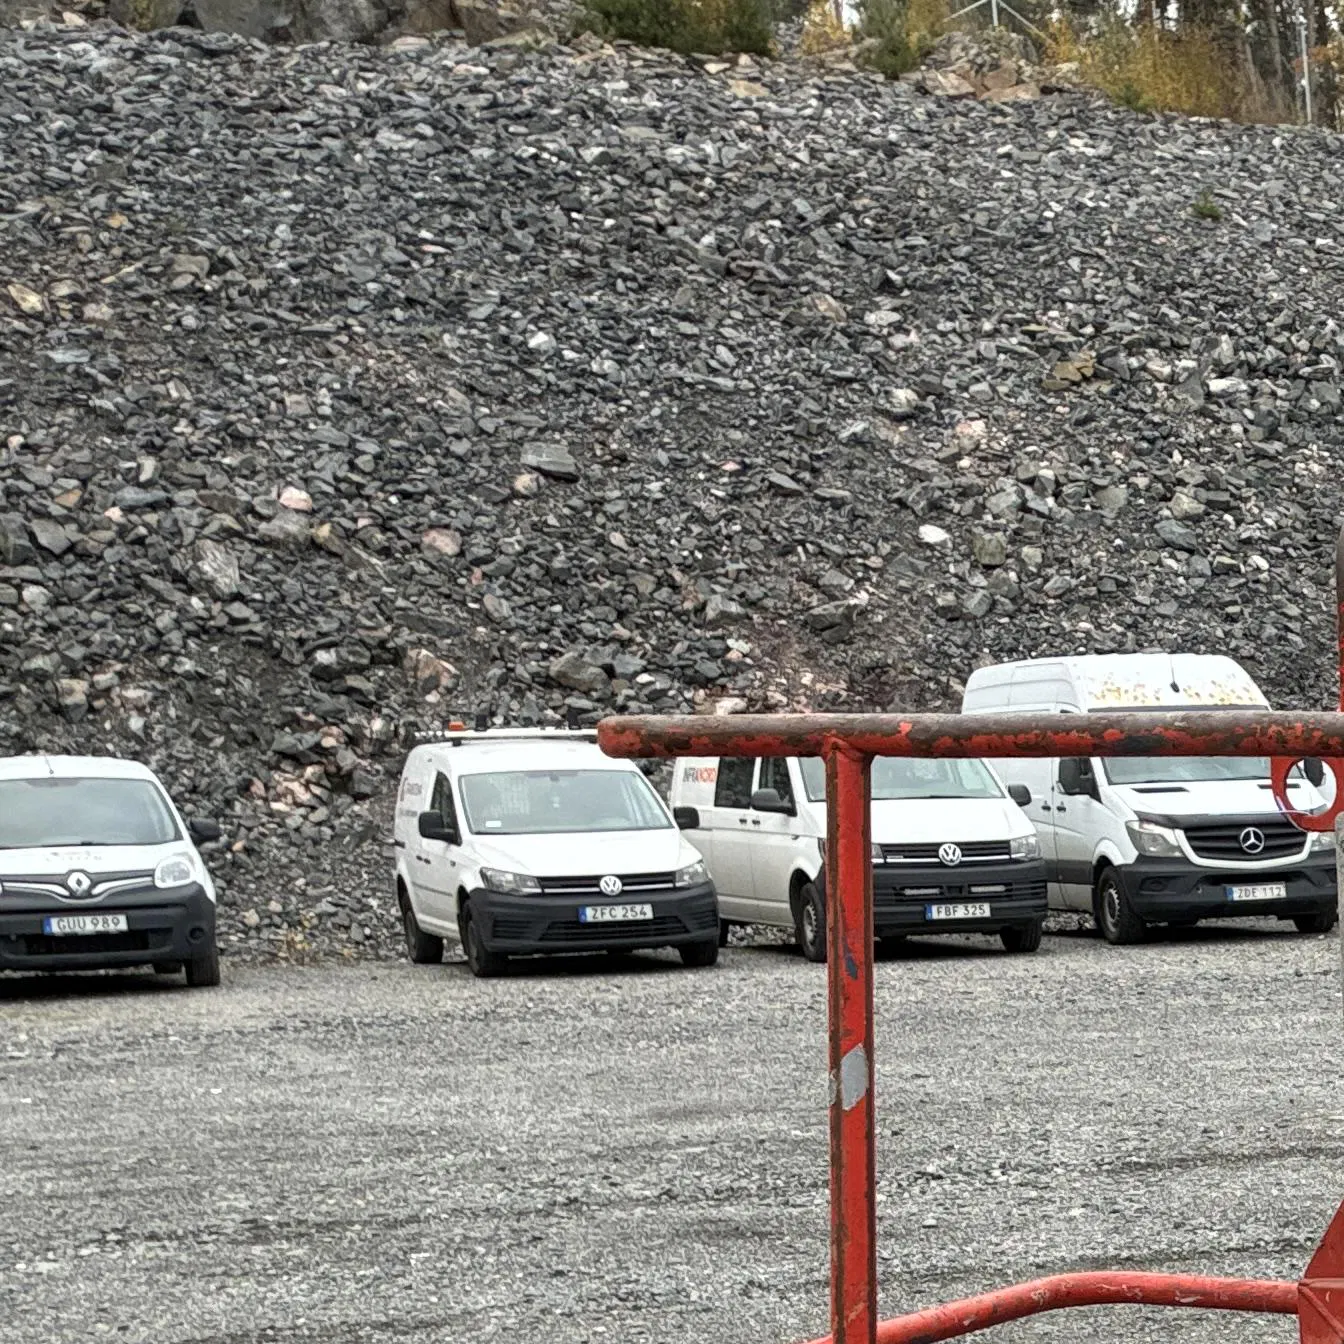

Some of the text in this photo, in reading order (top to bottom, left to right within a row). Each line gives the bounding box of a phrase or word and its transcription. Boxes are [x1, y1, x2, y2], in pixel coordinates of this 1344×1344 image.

[591, 905, 647, 920] ZFC 254
[936, 904, 986, 917] FBF 325
[57, 915, 120, 930] GUU 989
